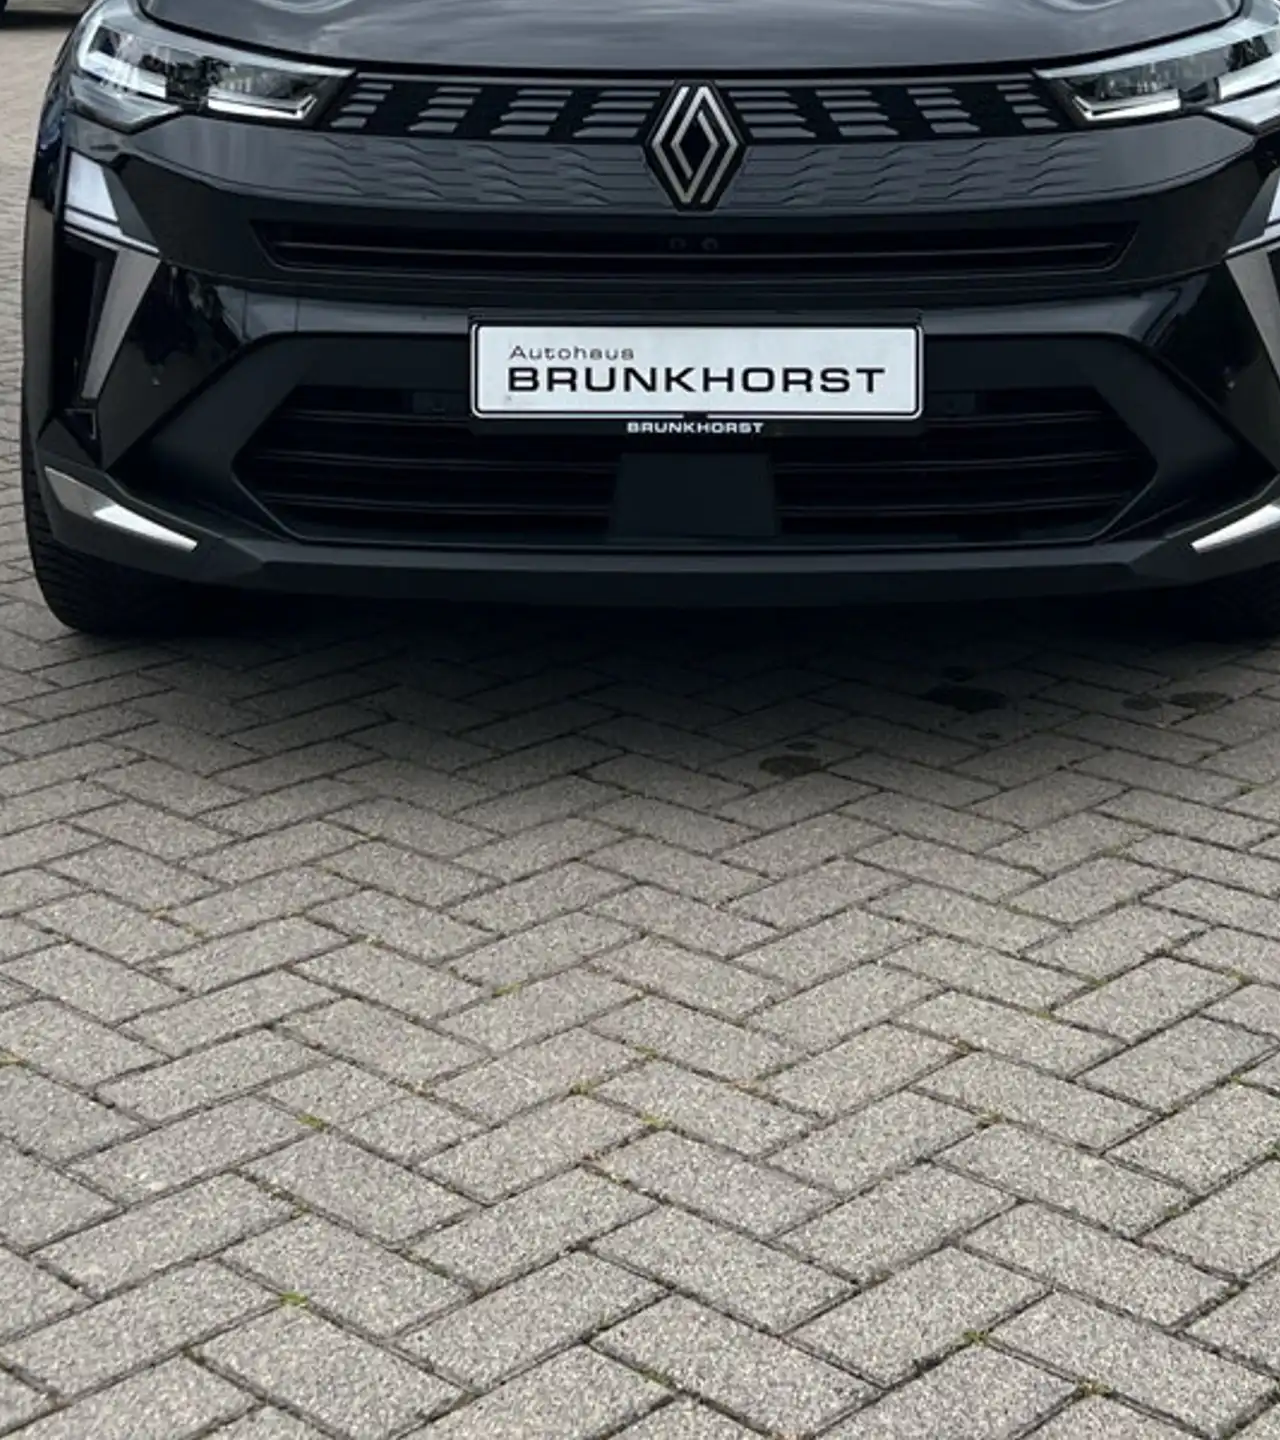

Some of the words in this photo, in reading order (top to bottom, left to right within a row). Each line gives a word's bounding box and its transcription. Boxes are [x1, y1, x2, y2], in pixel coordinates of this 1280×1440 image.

[510, 345, 634, 360] Autohaus
[508, 367, 885, 392] BRUNKHORST
[627, 422, 764, 433] BRUNKHORST
